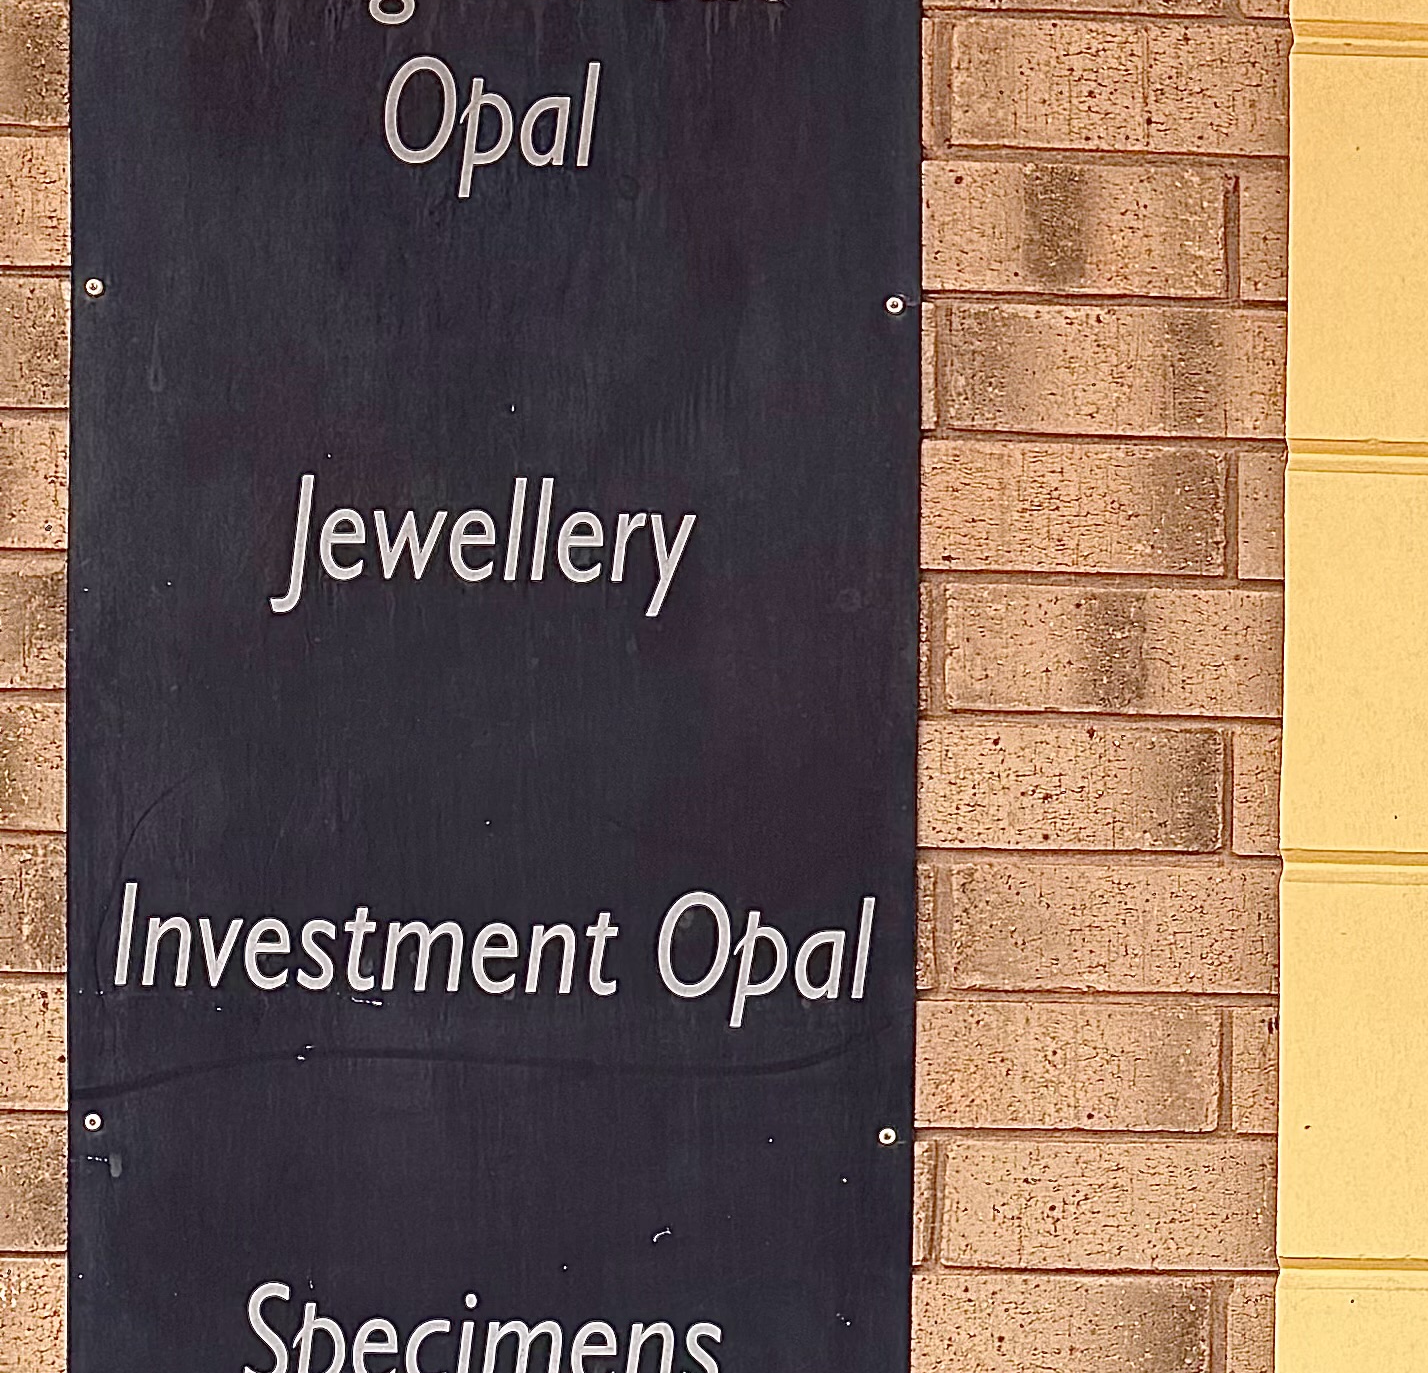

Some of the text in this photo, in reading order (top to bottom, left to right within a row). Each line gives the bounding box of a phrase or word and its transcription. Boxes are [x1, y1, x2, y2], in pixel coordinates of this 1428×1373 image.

[384, 56, 601, 198] Opal
[269, 474, 697, 617] Jewellery
[113, 882, 876, 1028] Investment Opal
